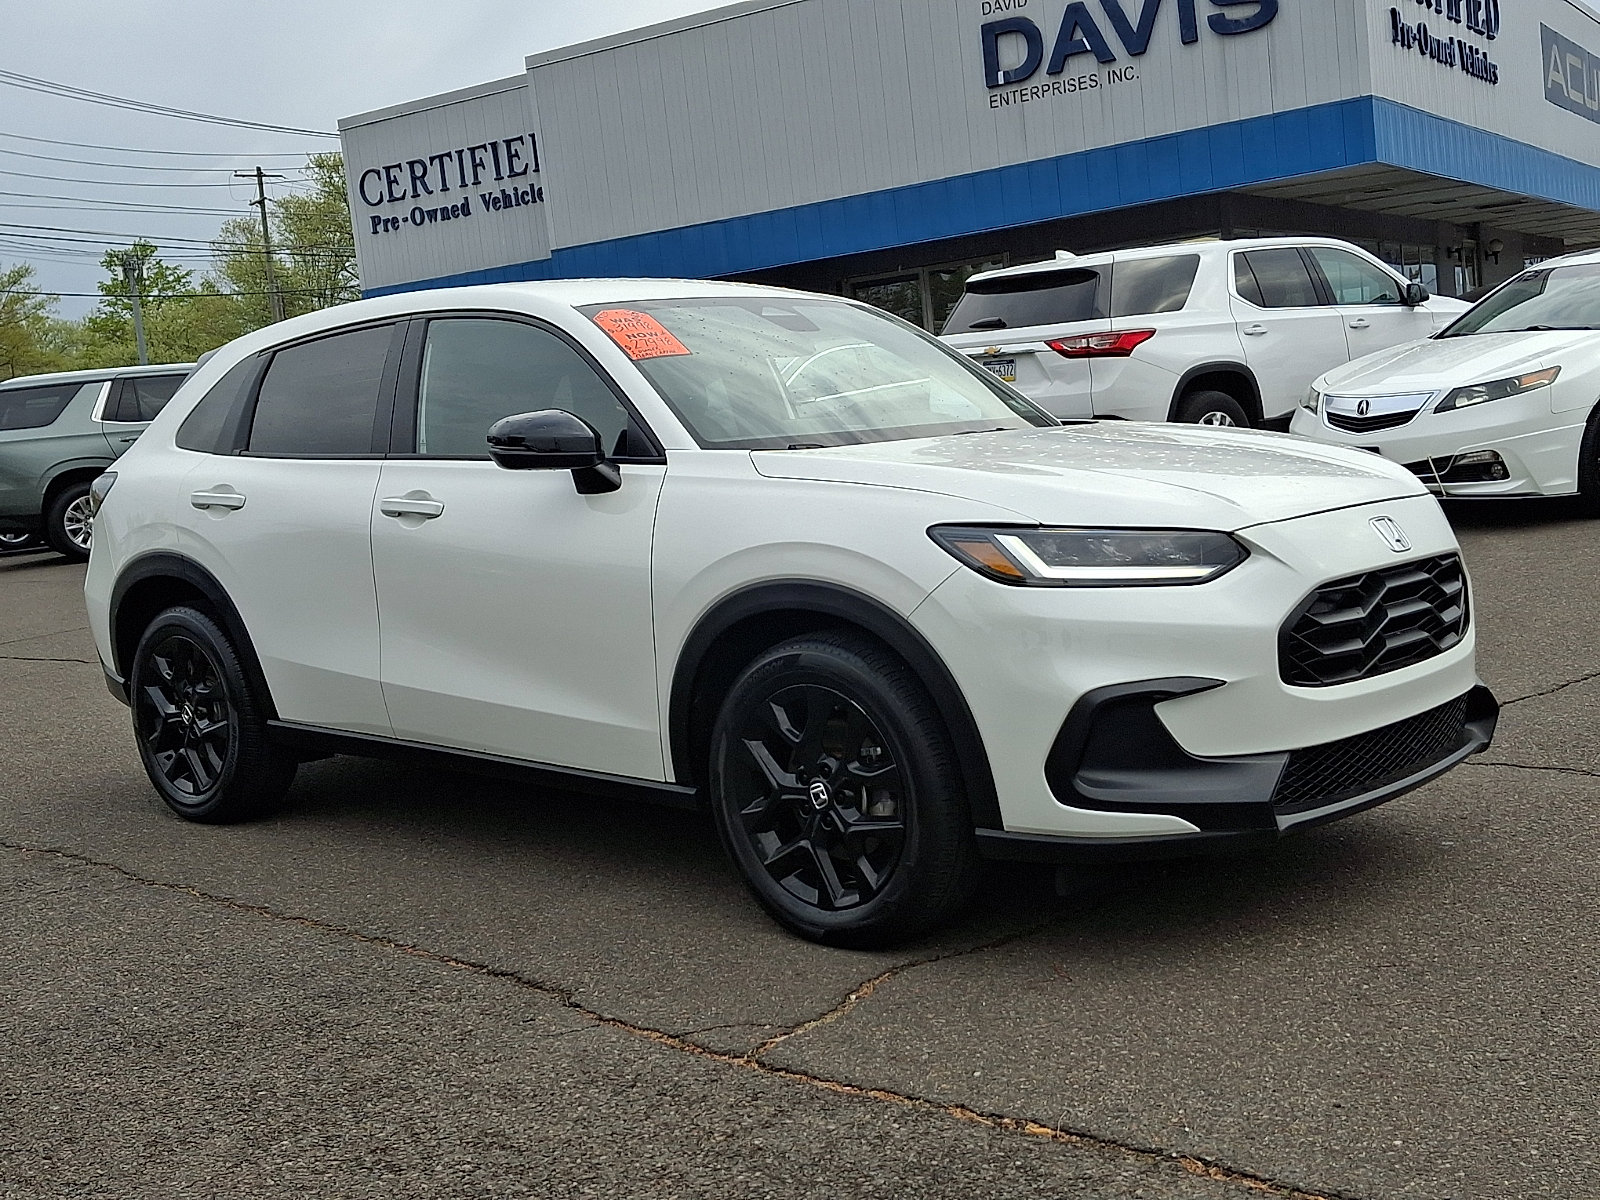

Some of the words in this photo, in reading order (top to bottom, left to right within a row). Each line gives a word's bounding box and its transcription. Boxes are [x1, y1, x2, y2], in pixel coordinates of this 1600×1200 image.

[981, 0, 1028, 16] DAVID
[1390, 7, 1457, 68] Pre-Owned
[1456, 39, 1499, 86] Vehicles
[988, 73, 1104, 109] ENTERPRISES,
[1107, 65, 1140, 84] INC.
[1547, 43, 1600, 111] ACU
[370, 196, 471, 235] Pre-Owned
